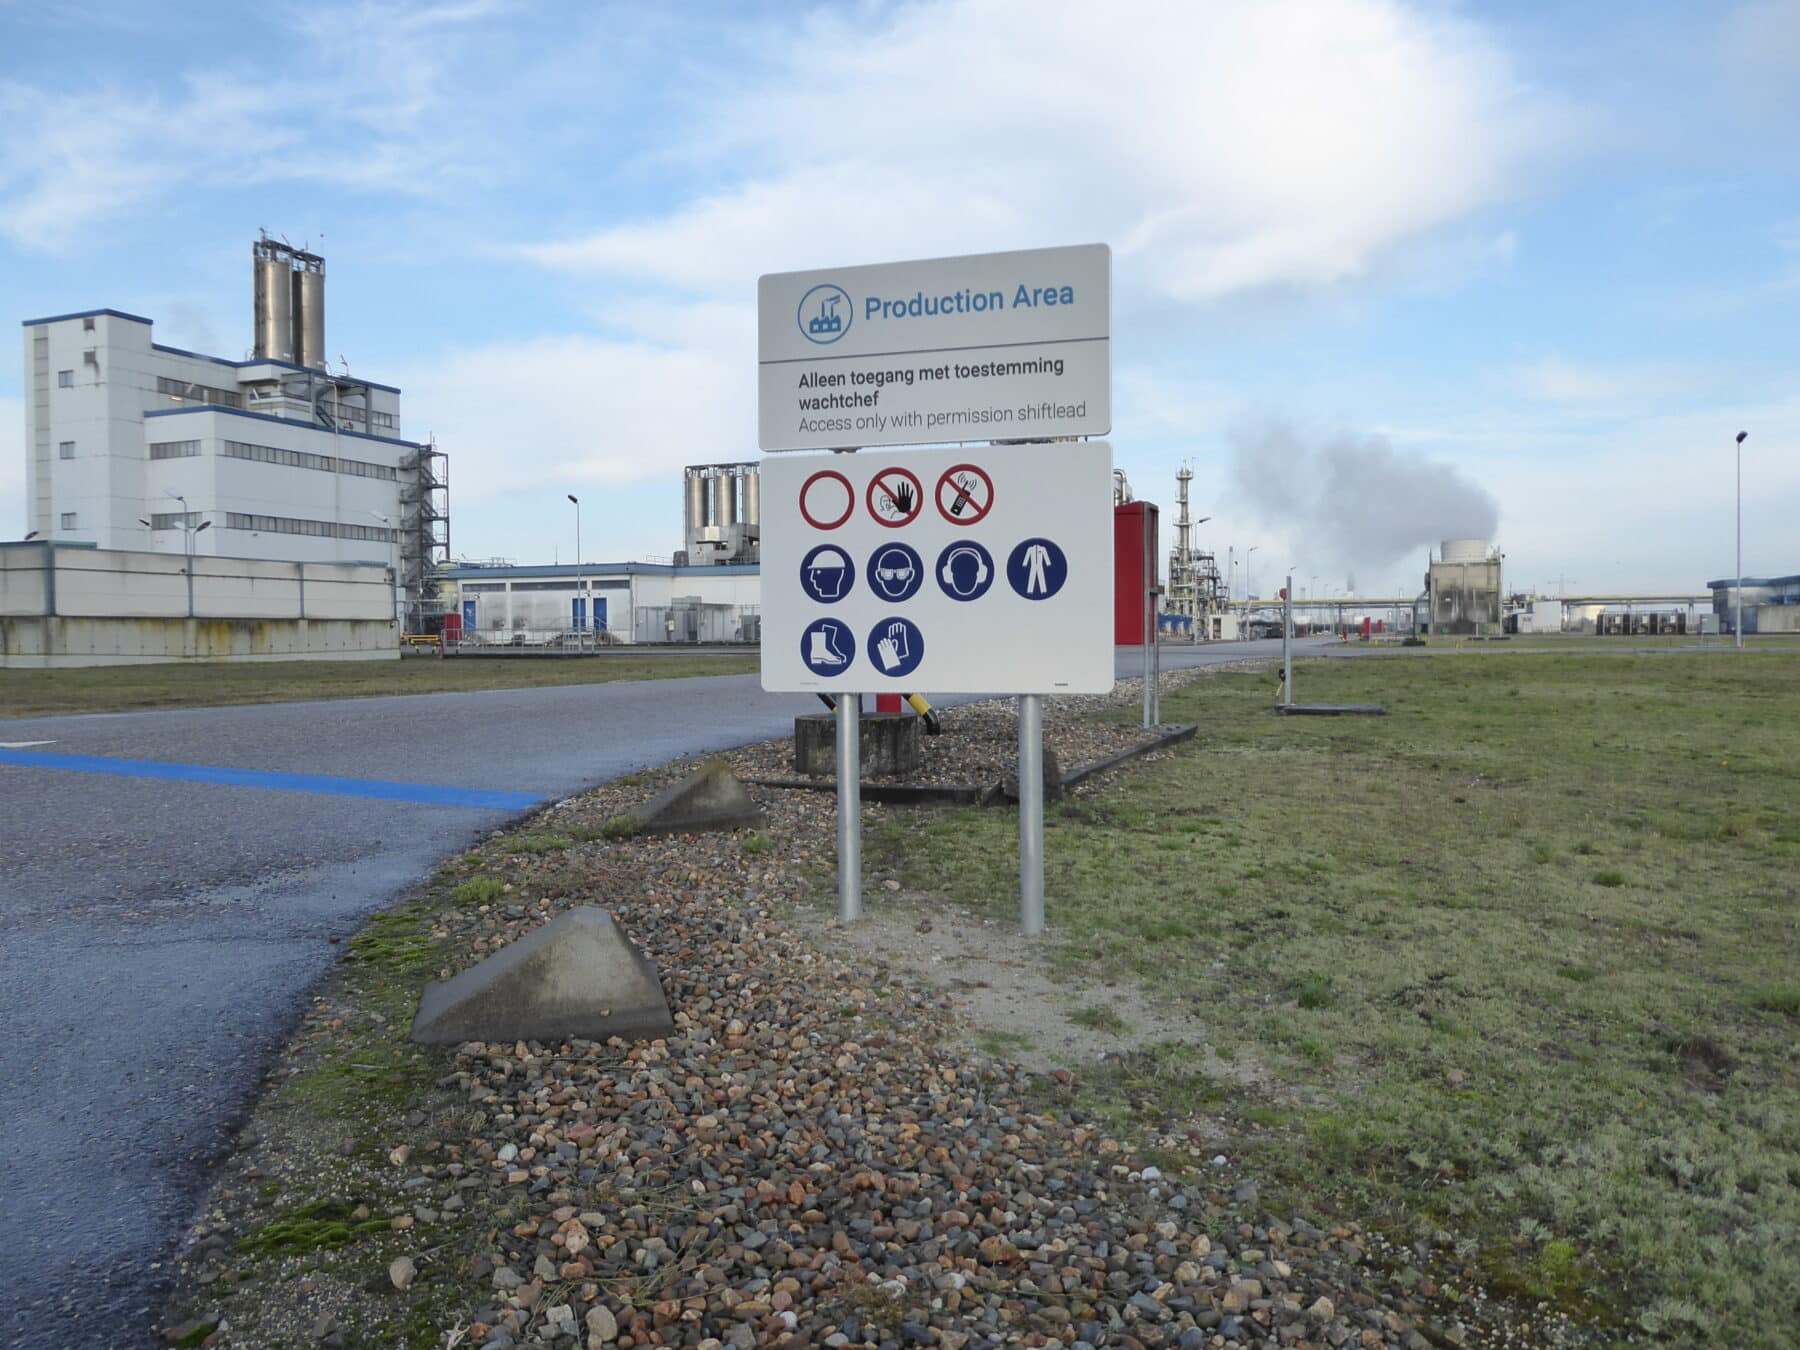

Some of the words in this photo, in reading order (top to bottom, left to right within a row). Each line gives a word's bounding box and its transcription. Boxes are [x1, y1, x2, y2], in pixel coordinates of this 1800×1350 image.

[865, 288, 1004, 321] Production
[1012, 284, 1074, 309] Area
[798, 371, 846, 388] Alleen
[851, 367, 914, 388] toegang
[919, 364, 950, 381] met
[954, 357, 1064, 378] toestemming
[798, 391, 879, 411] wachtchef
[798, 416, 852, 433] Access
[856, 411, 887, 432] only
[891, 409, 923, 428] with
[927, 406, 1013, 429] permission
[1018, 401, 1087, 421] shiftlead
